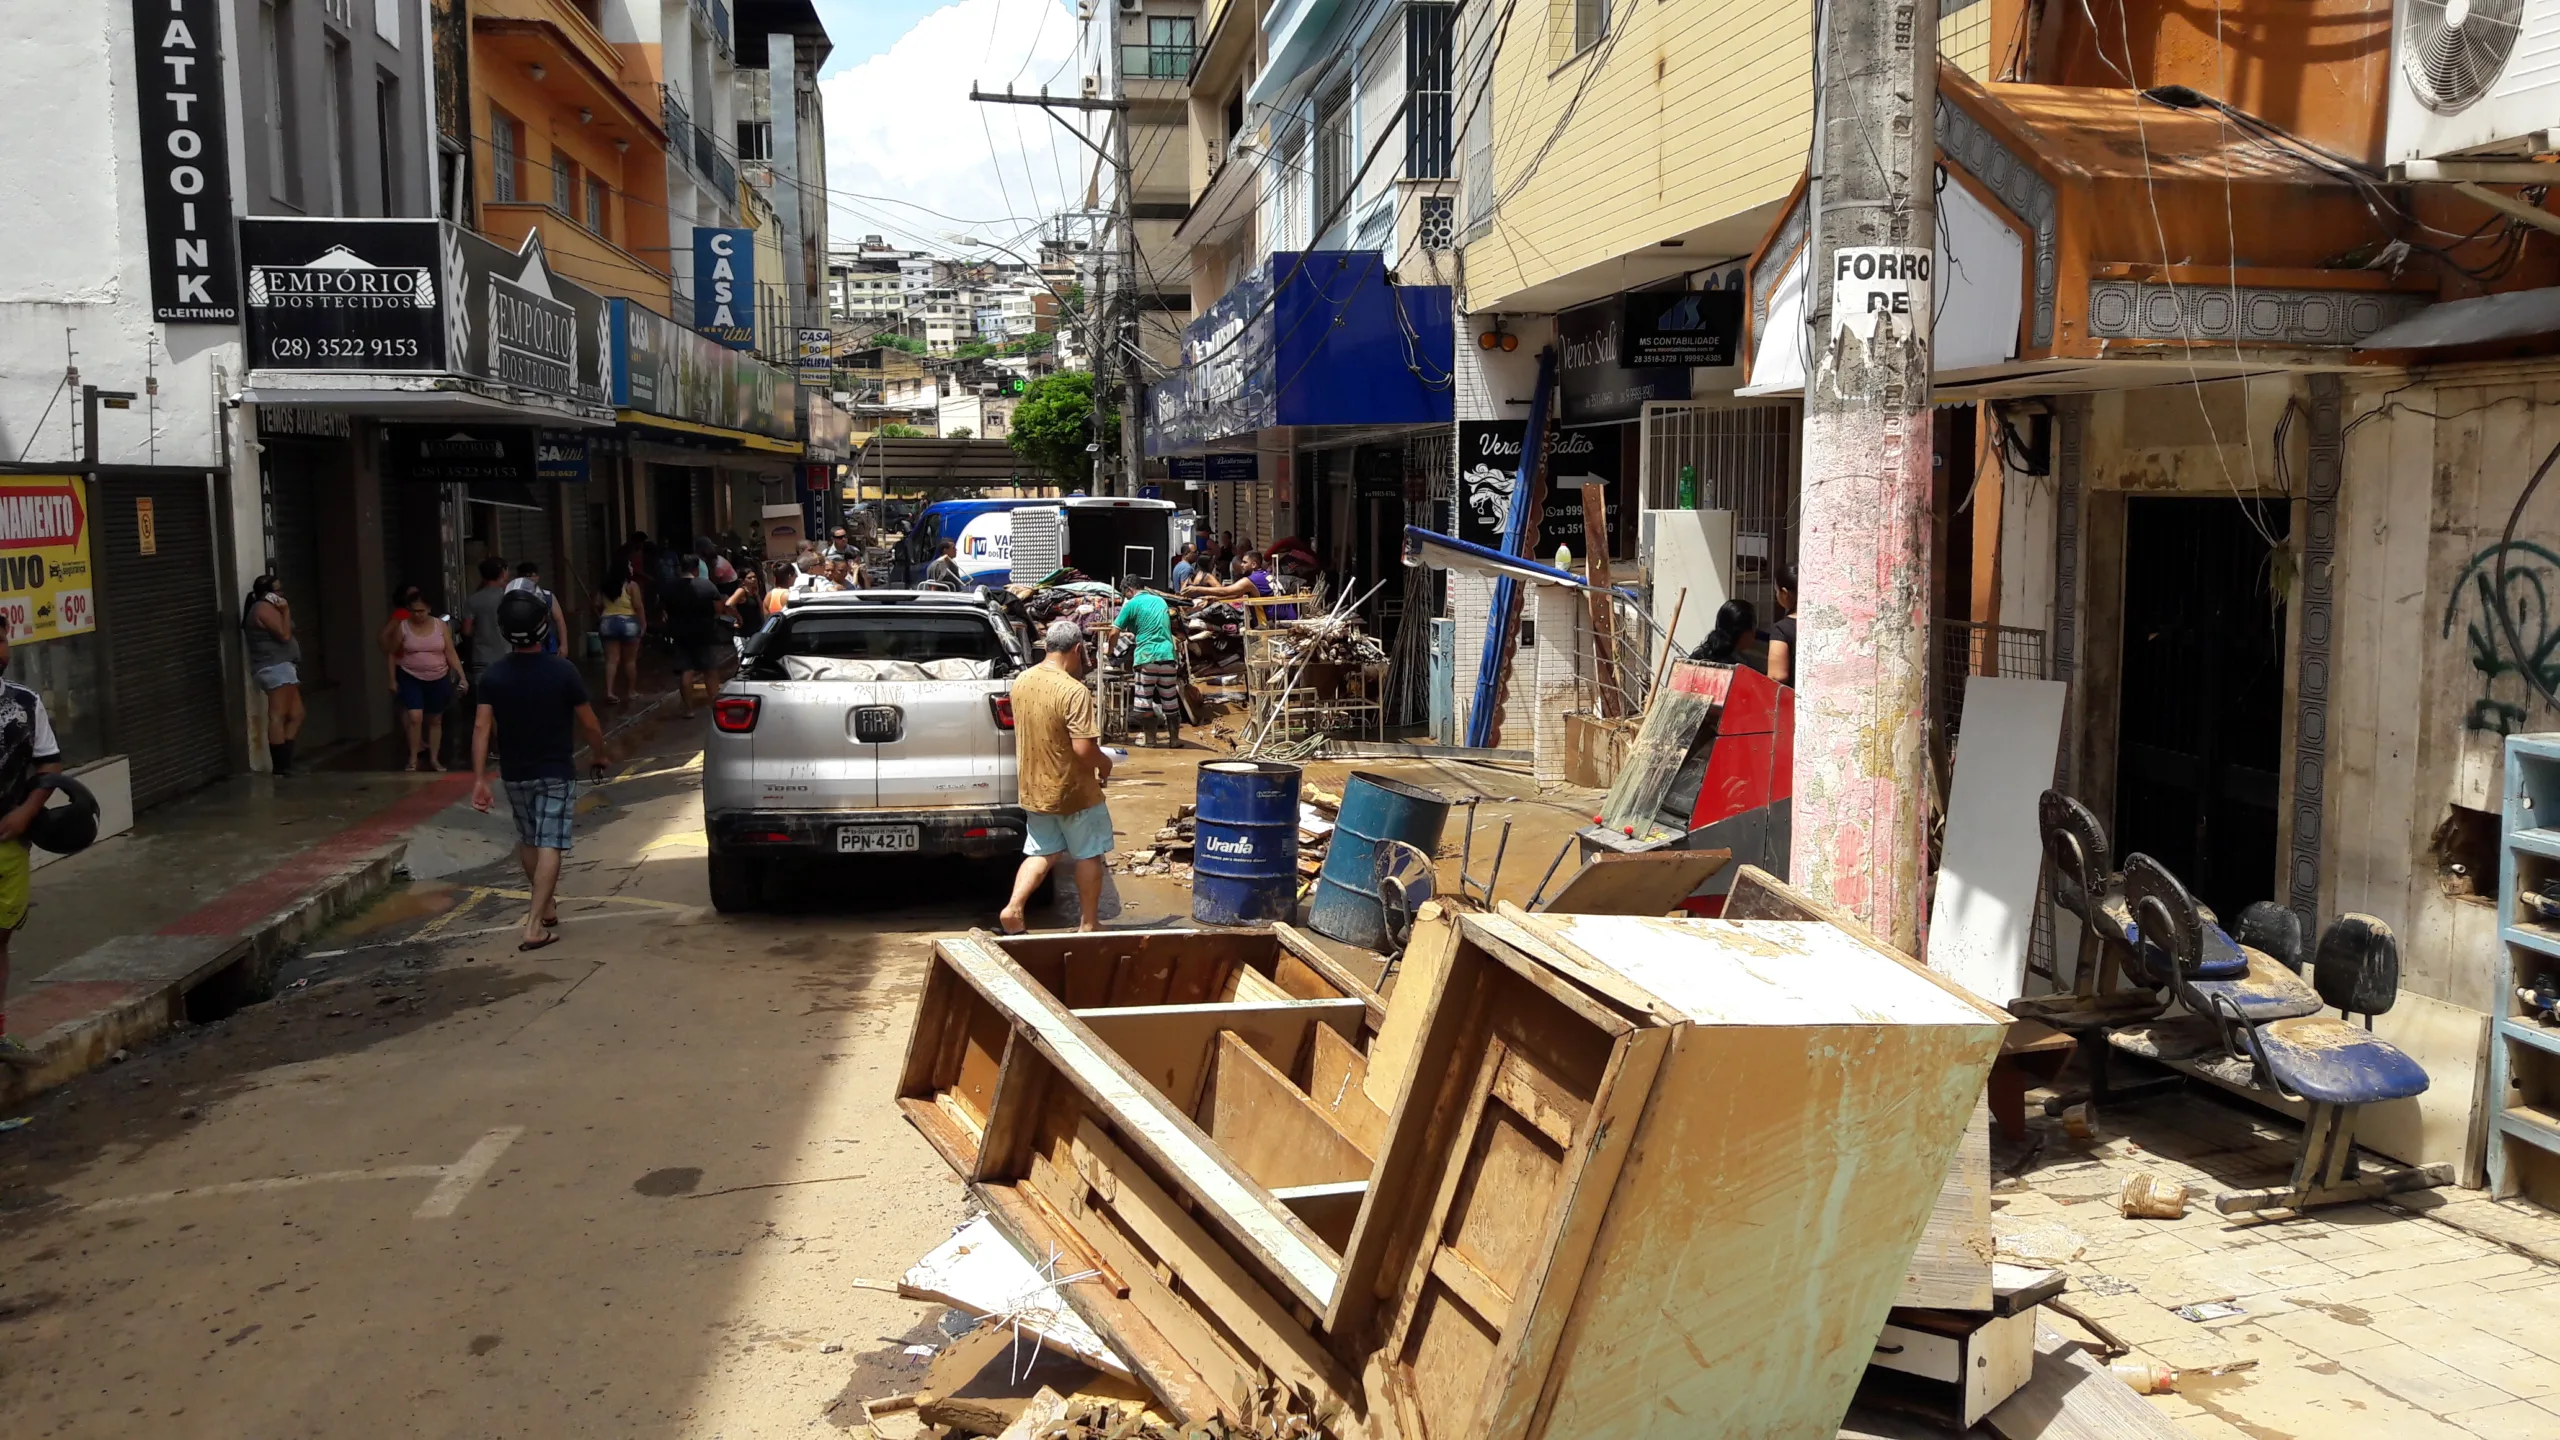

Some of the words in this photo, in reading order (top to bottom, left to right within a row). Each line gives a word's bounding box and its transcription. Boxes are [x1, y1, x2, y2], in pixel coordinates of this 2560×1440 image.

[1837, 252, 1930, 282] FORRO
[269, 269, 414, 293] EMPÓRIO
[710, 233, 735, 327] CASA
[157, 307, 235, 319] CLEITINHO
[275, 296, 314, 309] DOS
[320, 296, 411, 309] TECIDOS
[498, 292, 571, 359] EMPÓRIO
[630, 311, 650, 353] CASA
[799, 331, 830, 342] CASA
[1639, 337, 1652, 346] MS
[1653, 336, 1720, 346] CONTABILIDADE
[271, 337, 311, 360] (28)
[317, 338, 364, 357] 3522
[371, 338, 418, 357] 9153
[808, 345, 821, 354] DO
[1560, 334, 1593, 370] Vera's
[502, 352, 524, 383] DOS
[526, 358, 569, 393] TECIDOS
[799, 357, 831, 368] CICLISTA
[1013, 379, 1024, 391] 13
[260, 404, 294, 434] TEMOS
[297, 407, 351, 438] AVIAMENTOS
[538, 445, 562, 462] SA
[1479, 432, 1522, 456] Vera
[484, 466, 518, 478] 9153
[862, 710, 892, 734] FIAT
[841, 834, 916, 849] PPN-4210
[1206, 835, 1254, 855] Urania
